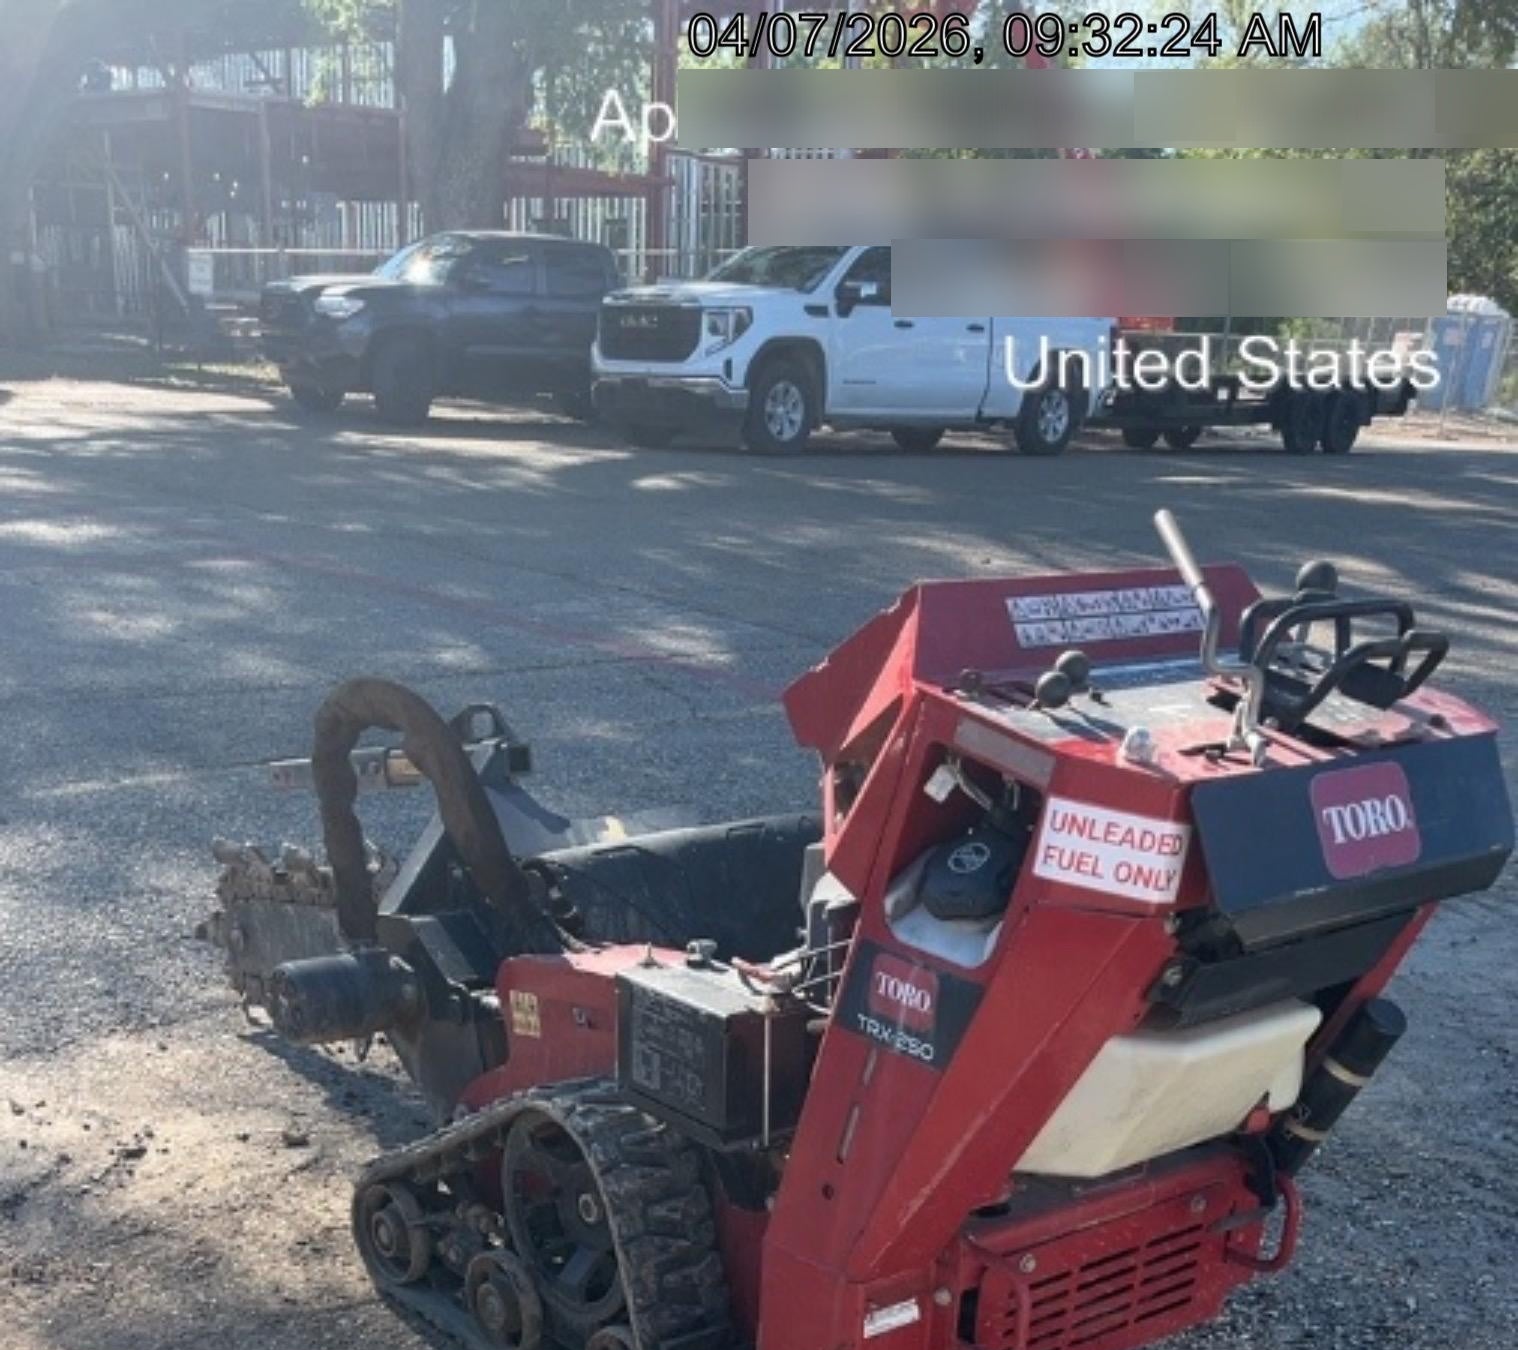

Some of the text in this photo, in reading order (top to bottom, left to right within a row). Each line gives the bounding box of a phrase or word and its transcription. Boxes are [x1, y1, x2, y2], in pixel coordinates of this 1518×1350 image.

[1049, 809, 1184, 857] UNLEADED
[1322, 795, 1407, 844] TORO
[1043, 844, 1178, 892] FUEL ONLY
[876, 971, 931, 1012] TORO
